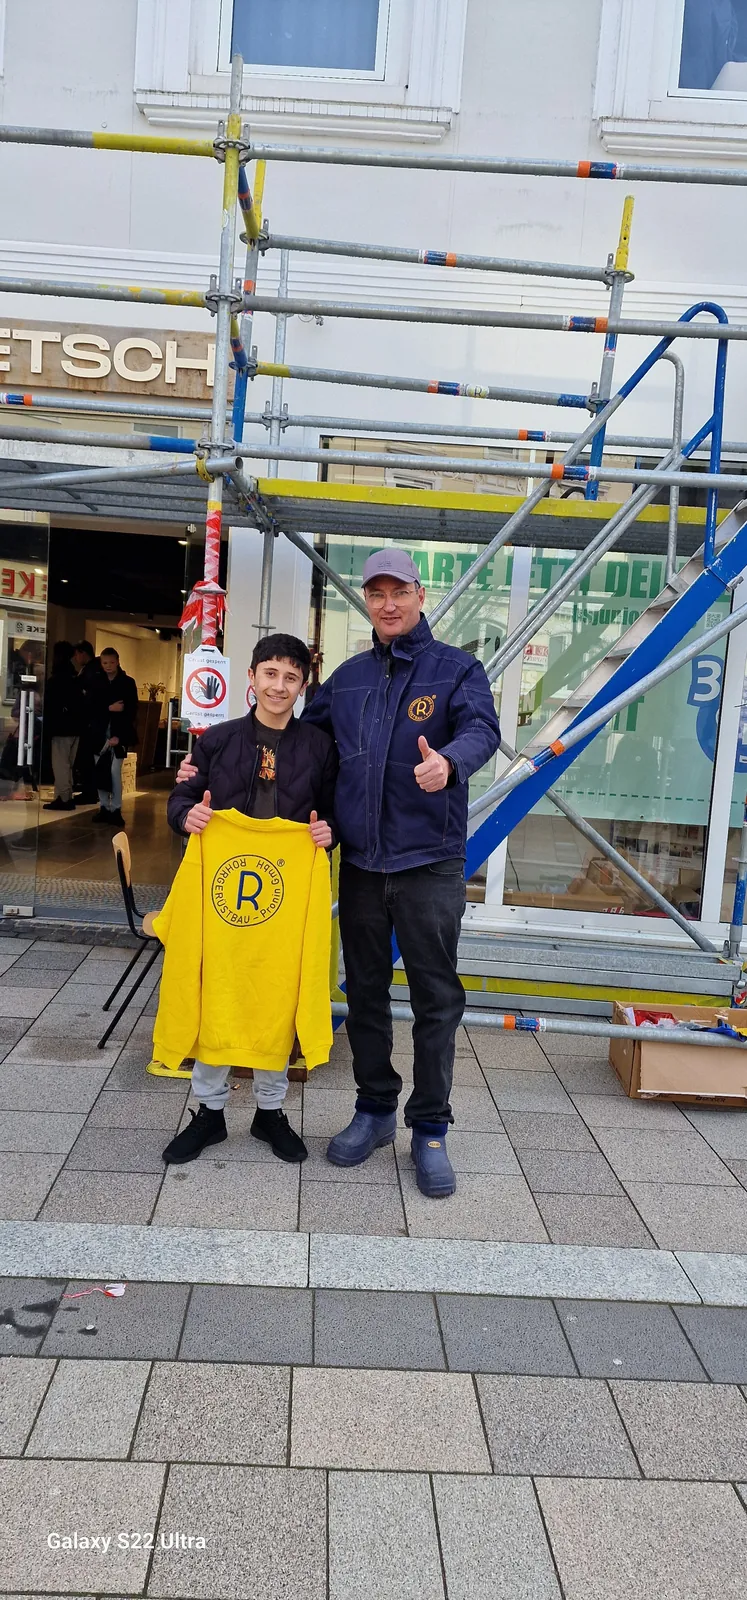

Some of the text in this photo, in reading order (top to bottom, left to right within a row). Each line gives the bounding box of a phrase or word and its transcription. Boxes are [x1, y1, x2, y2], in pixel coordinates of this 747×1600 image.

[0, 328, 215, 387] TSCH
[369, 548, 495, 591] ARTE
[693, 660, 722, 702] 3
[417, 701, 426, 715] R
[236, 870, 263, 911] R
[256, 860, 280, 886] GmbH
[260, 888, 281, 918] Pronin
